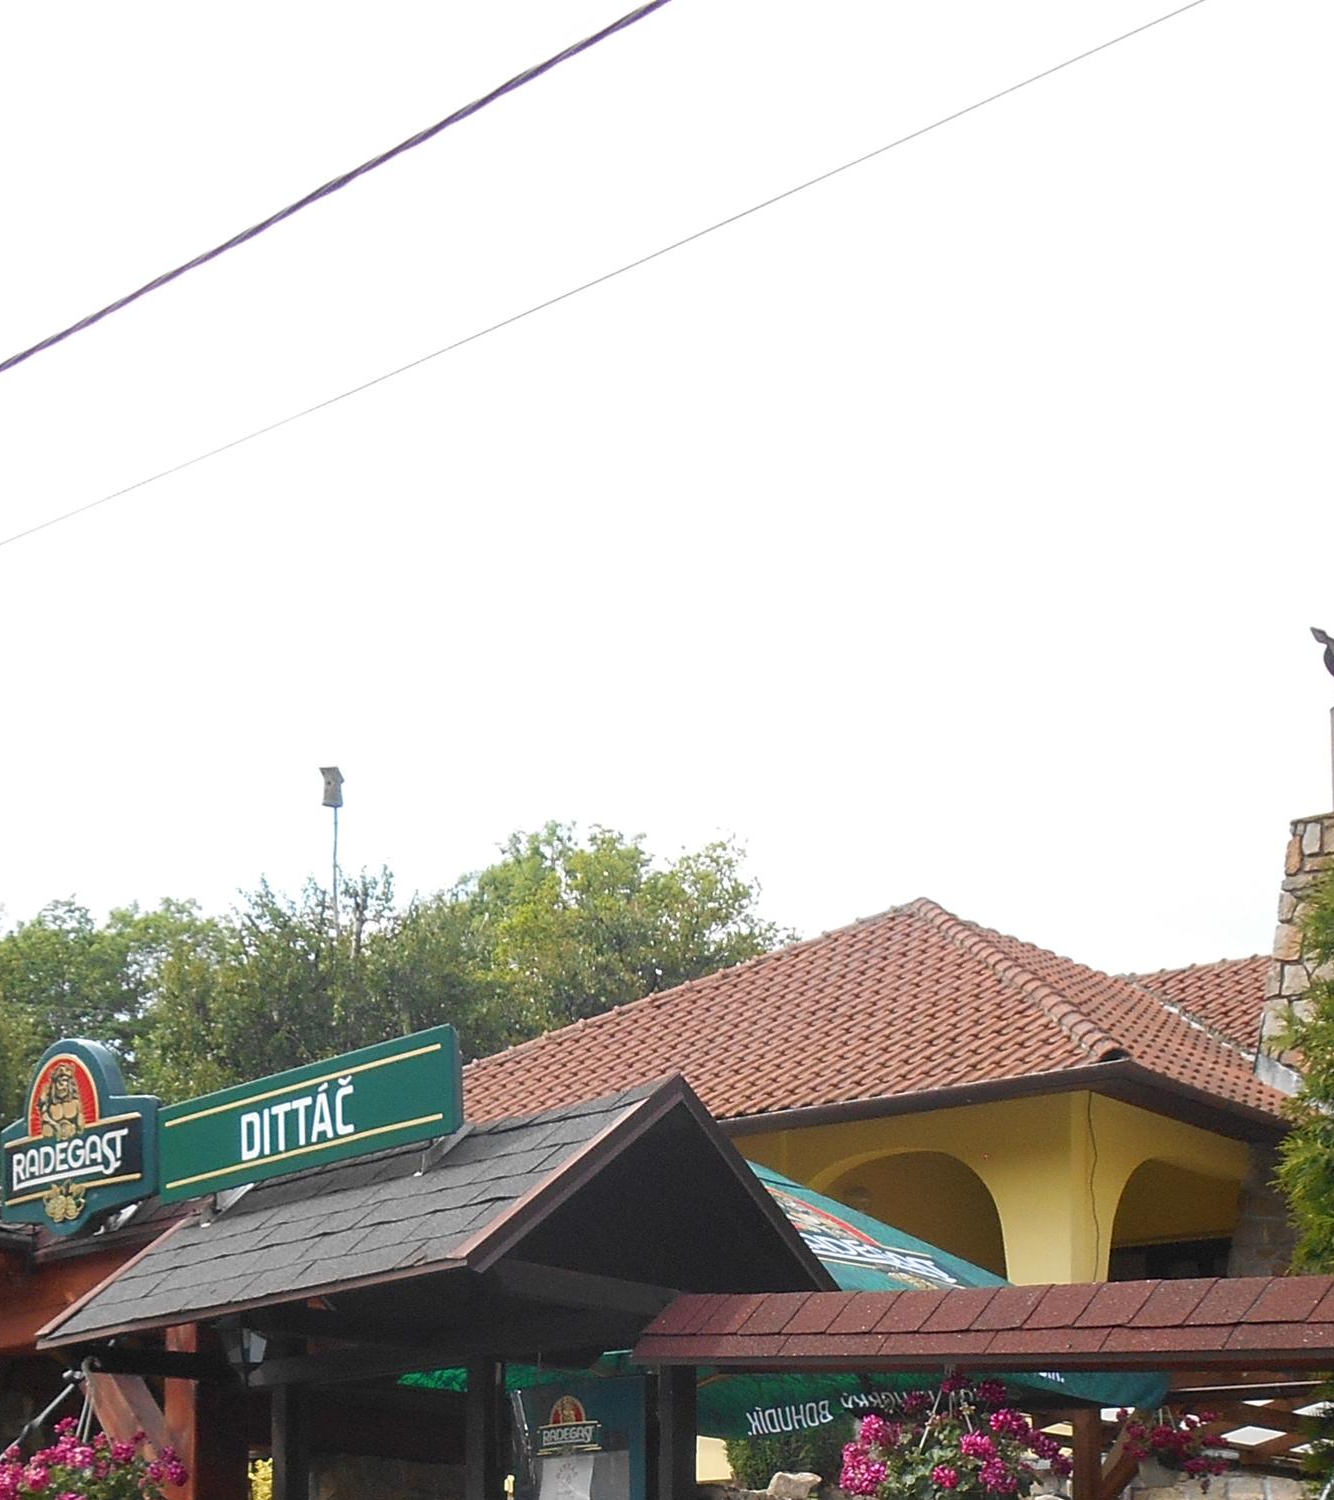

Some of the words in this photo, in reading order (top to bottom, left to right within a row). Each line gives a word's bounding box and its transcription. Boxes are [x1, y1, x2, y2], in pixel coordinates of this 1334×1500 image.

[241, 1075, 355, 1161] DITTÁČ
[12, 1128, 129, 1191] RADEGAST
[799, 1232, 957, 1284] ADEGAST
[542, 1425, 595, 1446] RADEGAST
